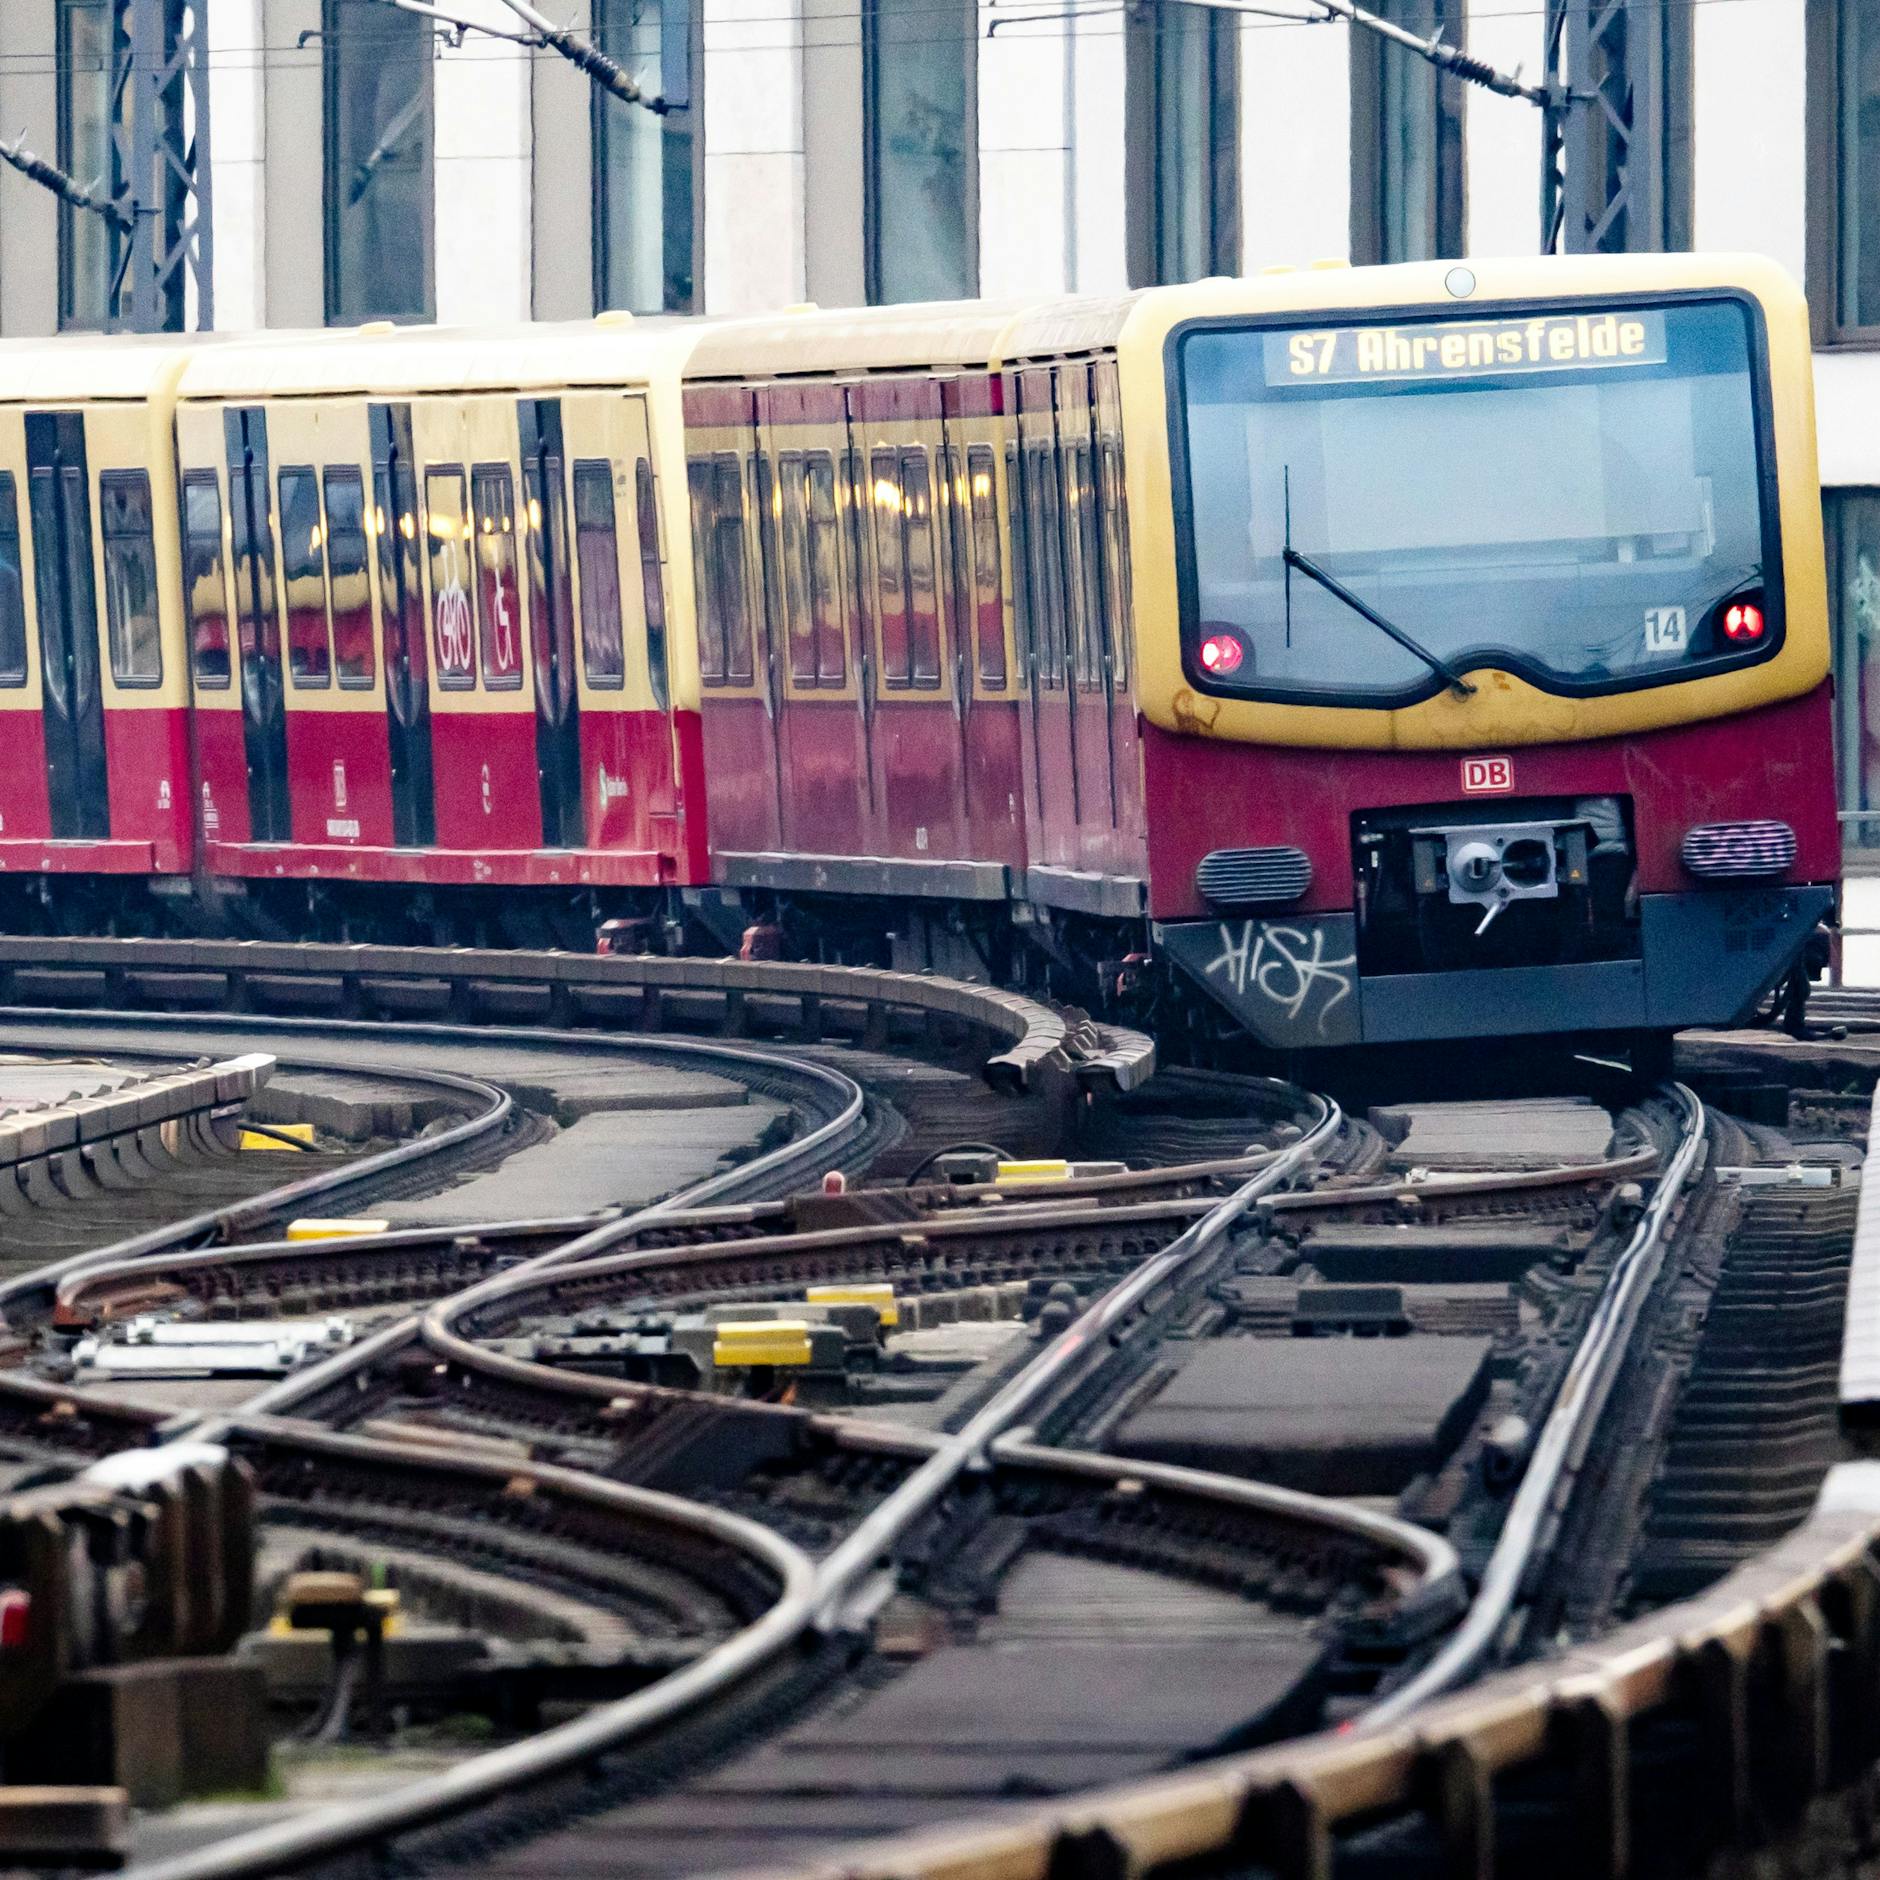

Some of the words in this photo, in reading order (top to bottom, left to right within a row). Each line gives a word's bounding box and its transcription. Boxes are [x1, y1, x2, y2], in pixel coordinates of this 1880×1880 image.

[1288, 332, 1337, 375] S7
[1357, 315, 1645, 372] Ahrensfelde
[1646, 611, 1681, 644] 14
[1468, 762, 1507, 786] DB
